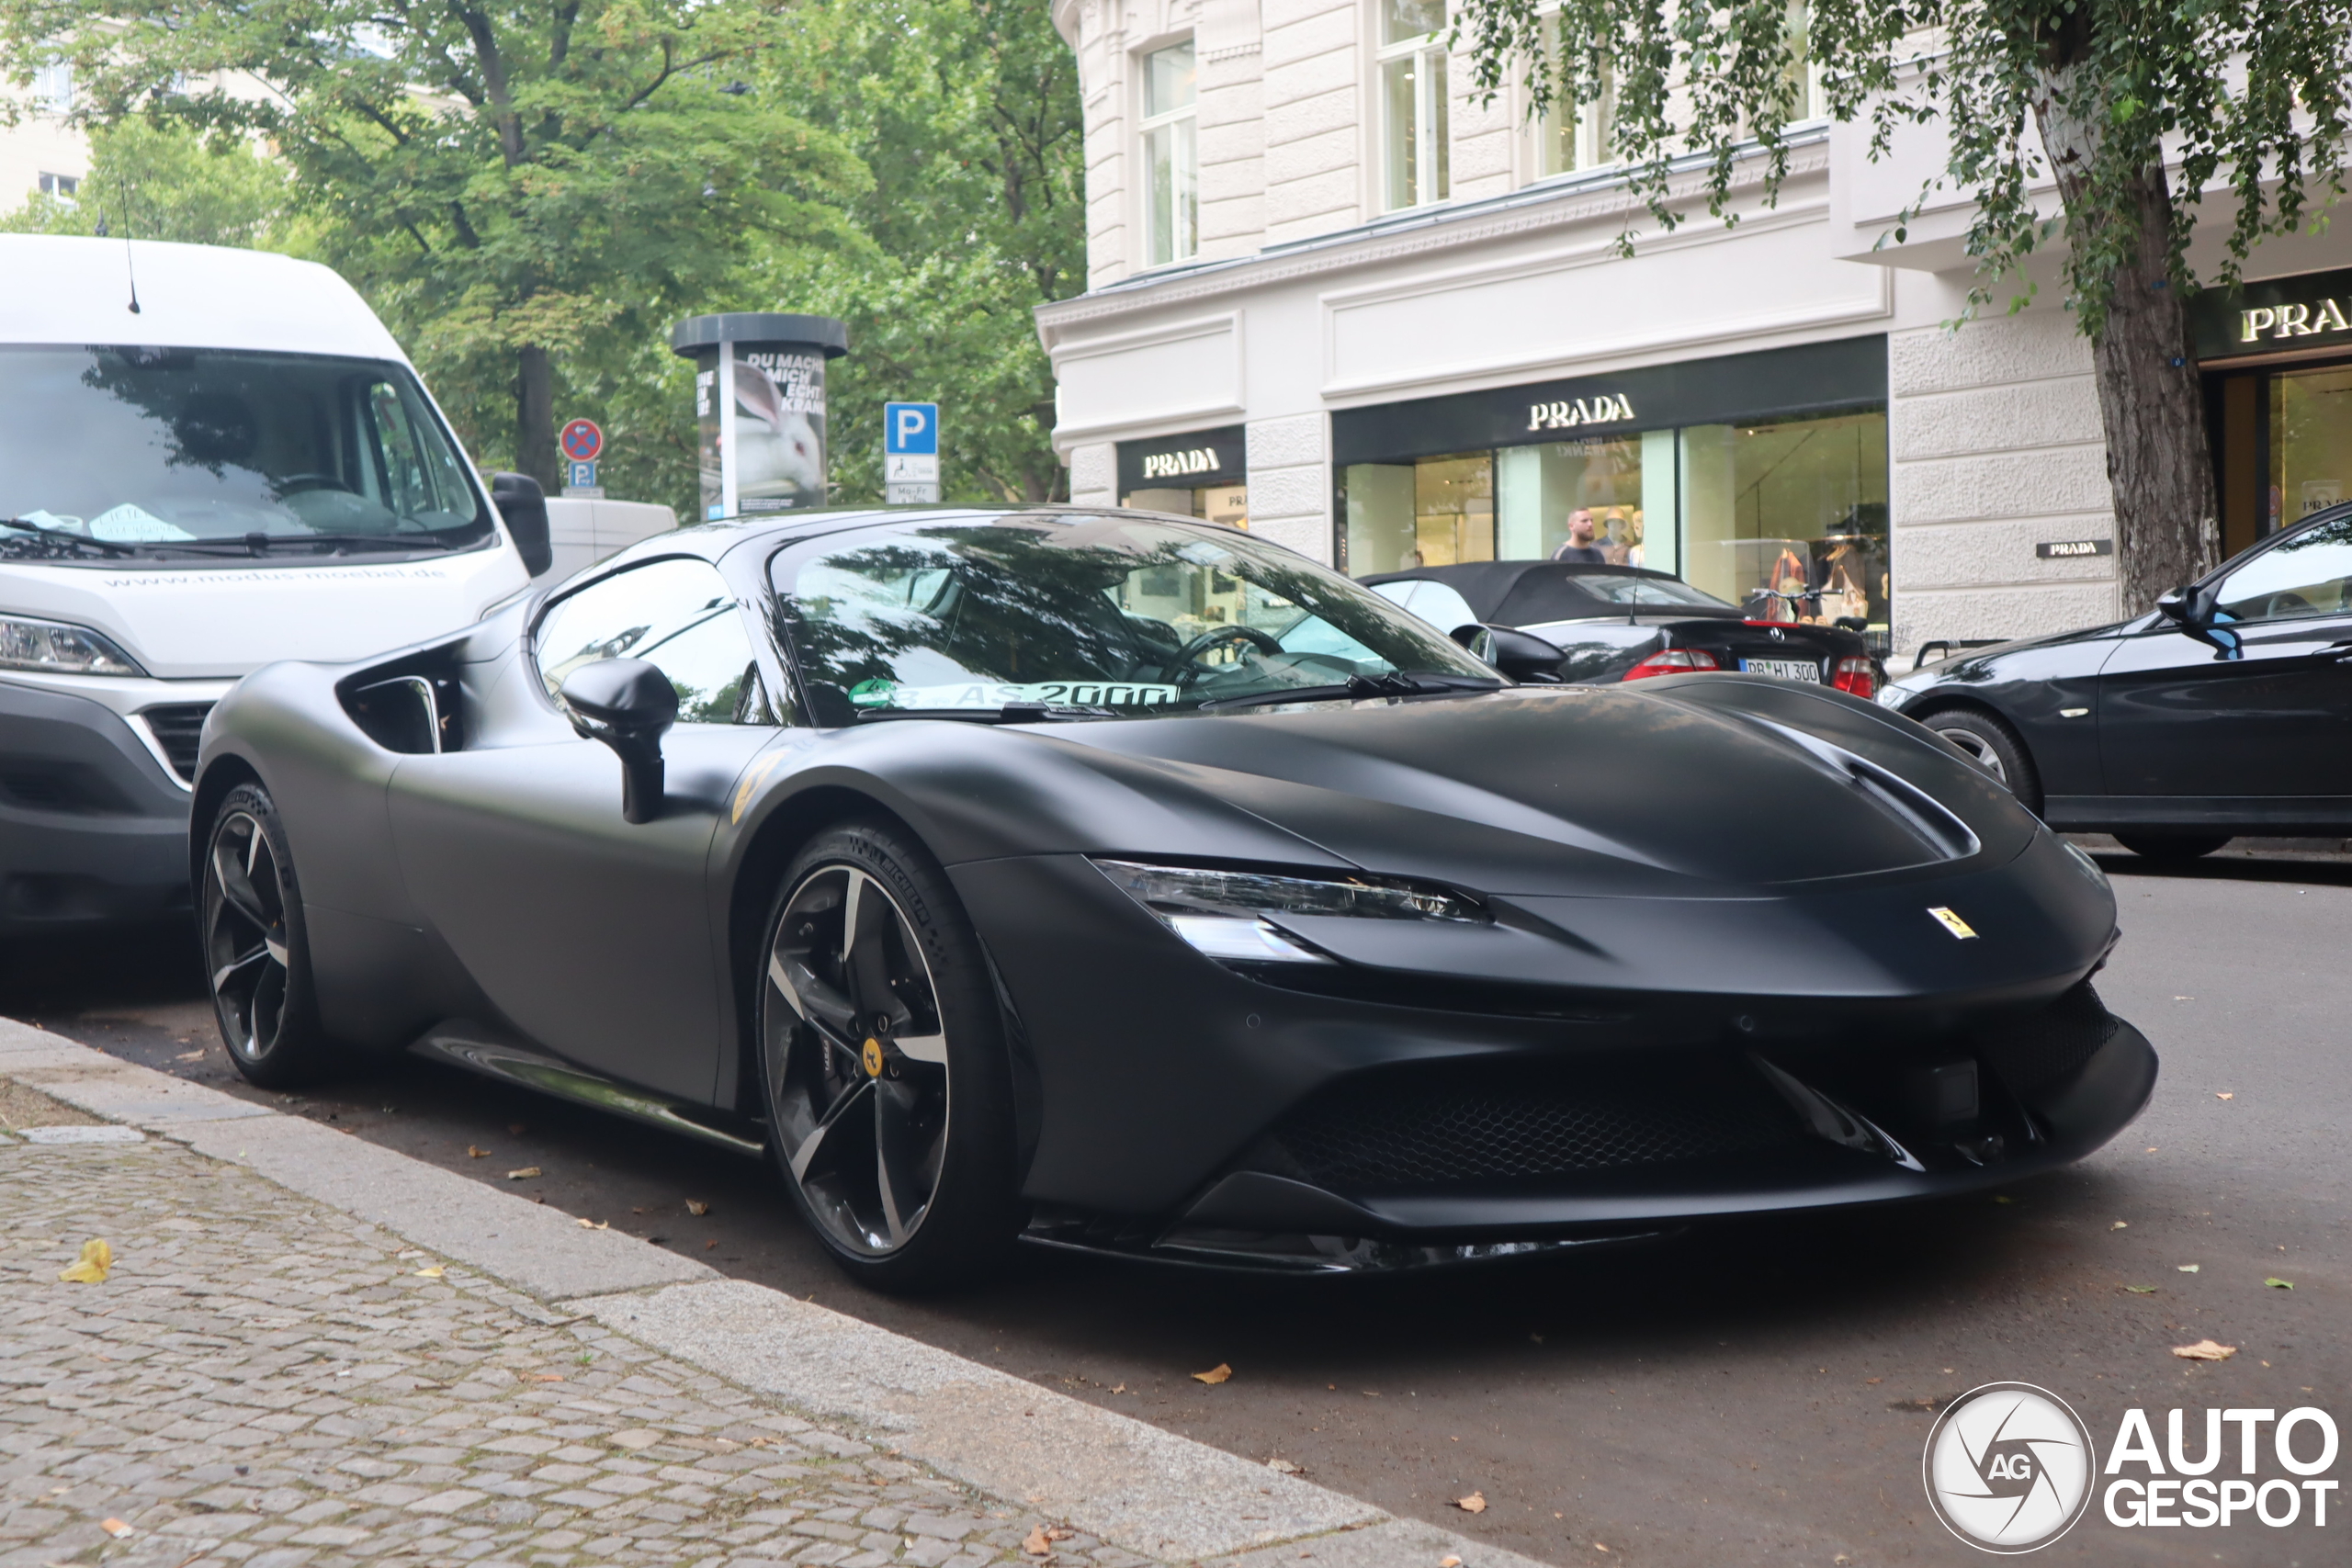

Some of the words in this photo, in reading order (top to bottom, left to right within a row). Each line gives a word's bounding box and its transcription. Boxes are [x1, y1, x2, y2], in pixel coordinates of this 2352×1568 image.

[2240, 296, 2352, 343] PRA
[747, 353, 775, 367] DU
[764, 367, 810, 384] MICH
[786, 383, 821, 400] ECHT
[1527, 393, 1635, 431] PRADA
[898, 410, 926, 449] P
[1143, 447, 1221, 479] PRADA
[575, 465, 589, 485] P
[2049, 541, 2097, 556] PRADA
[103, 567, 447, 588] www.modus-moebel.de
[1773, 662, 1790, 678] HI
[1792, 663, 1818, 681] 300
[1043, 683, 1170, 705] 2000
[882, 856, 931, 924] MICHELIN
